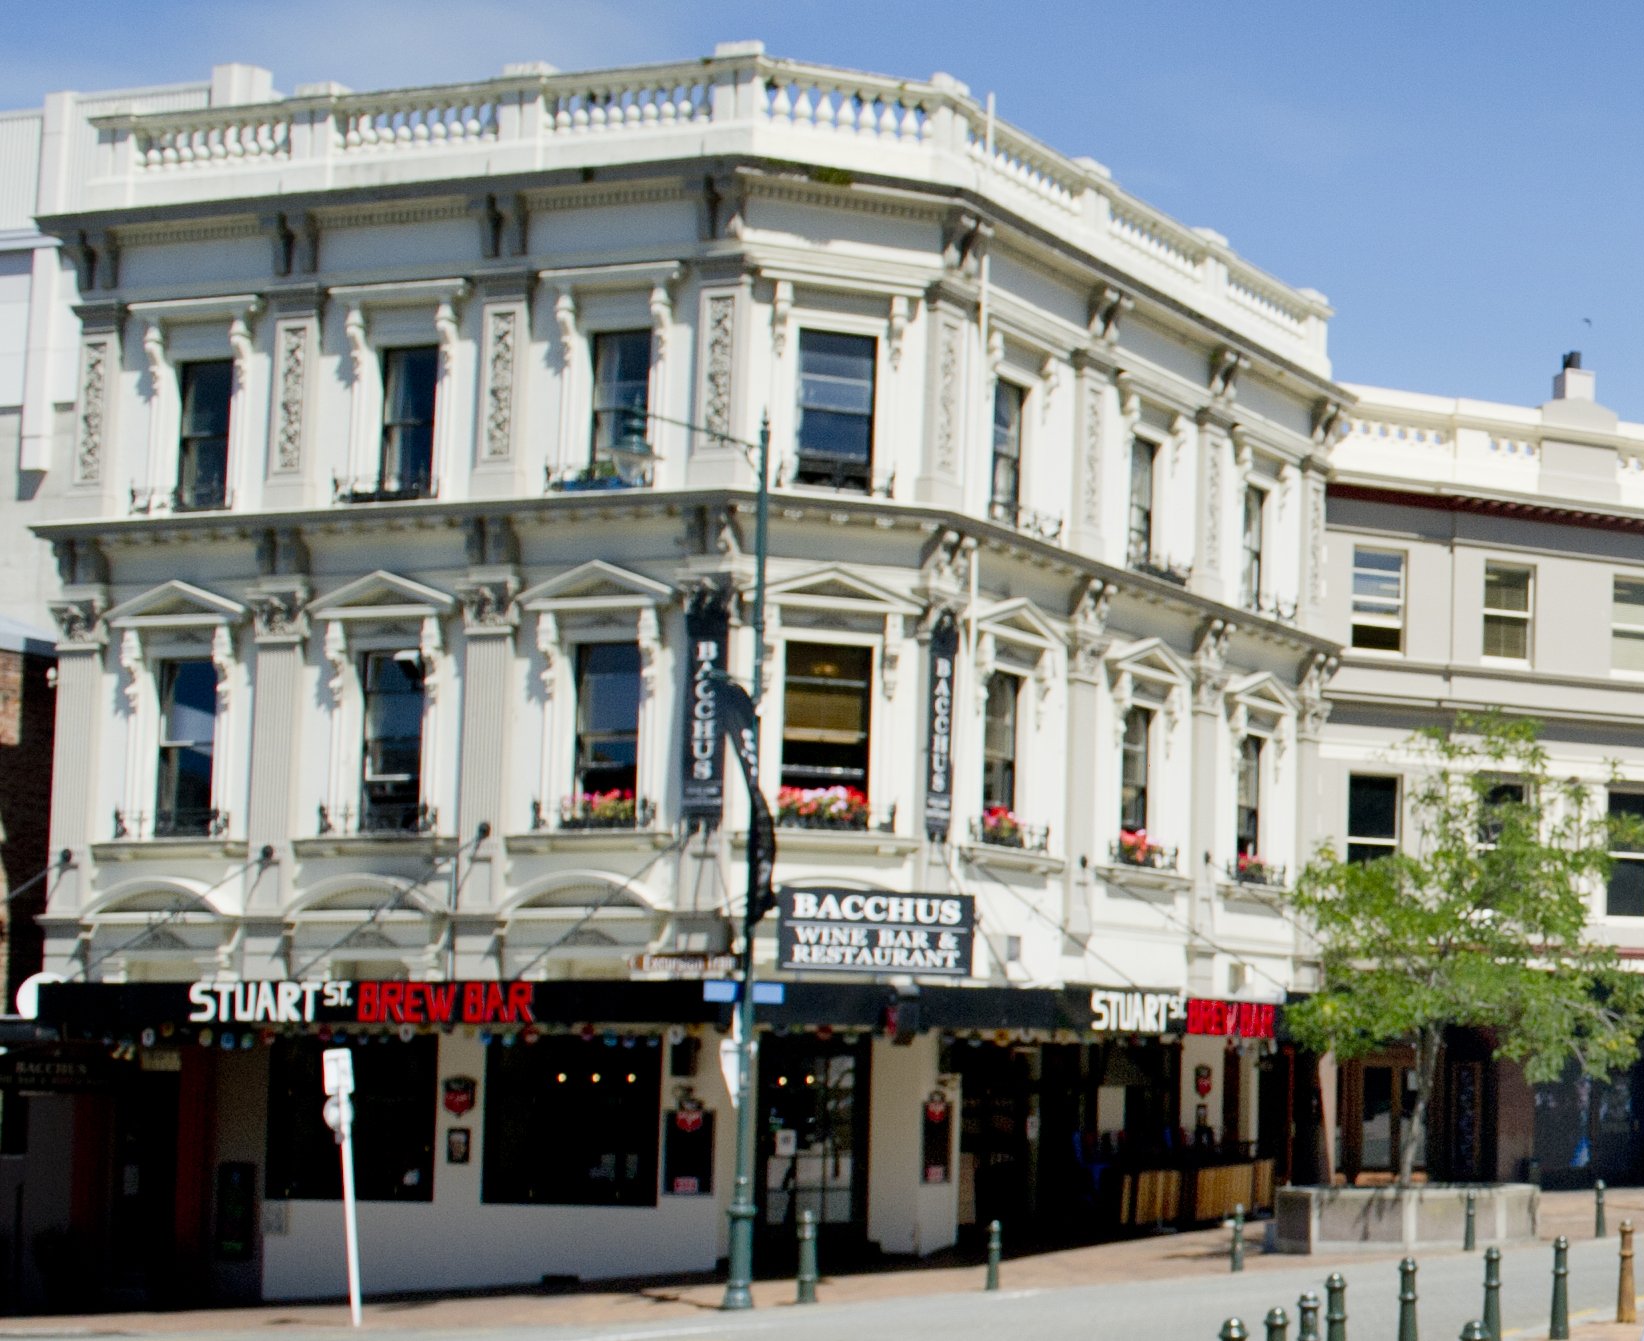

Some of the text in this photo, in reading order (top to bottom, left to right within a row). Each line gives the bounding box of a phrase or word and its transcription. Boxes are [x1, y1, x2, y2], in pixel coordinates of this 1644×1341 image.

[692, 640, 718, 780] BACCHUS
[932, 657, 951, 793] BACCHUS
[792, 892, 962, 925] BACCHUS
[792, 944, 961, 968] RESTAURANT
[795, 926, 959, 950] WINE BAR &
[188, 981, 323, 1022] STUART
[357, 981, 455, 1023] BREW
[463, 981, 534, 1023] BAR
[1091, 990, 1168, 1033] STUART
[1187, 998, 1239, 1035] BREW
[1241, 1002, 1275, 1038] BAR
